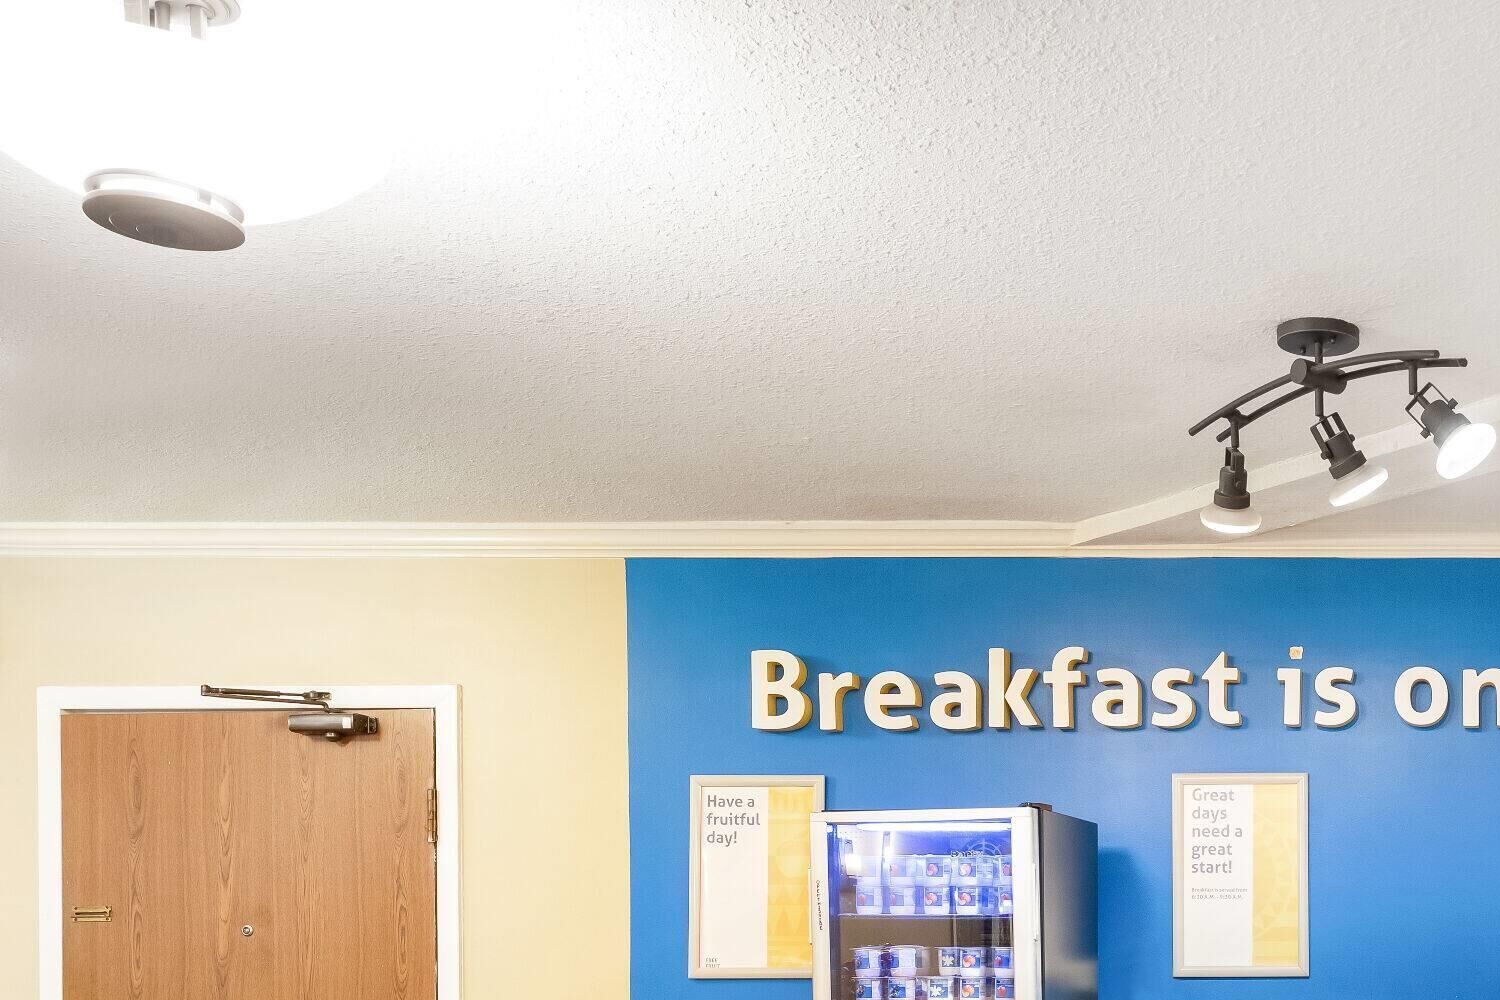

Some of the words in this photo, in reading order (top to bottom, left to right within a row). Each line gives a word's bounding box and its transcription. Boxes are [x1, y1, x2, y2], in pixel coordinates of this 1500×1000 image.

[750, 646, 1243, 733] Breakfast
[1276, 646, 1358, 730] is
[706, 794, 744, 808] Have
[747, 798, 755, 808] a
[1192, 787, 1235, 801] Great
[706, 812, 761, 826] fruitful
[1191, 805, 1228, 824] days
[1191, 824, 1230, 838] need
[1234, 826, 1243, 838] a
[706, 831, 738, 848] day!
[1191, 843, 1233, 860] great
[1191, 860, 1233, 874] start!
